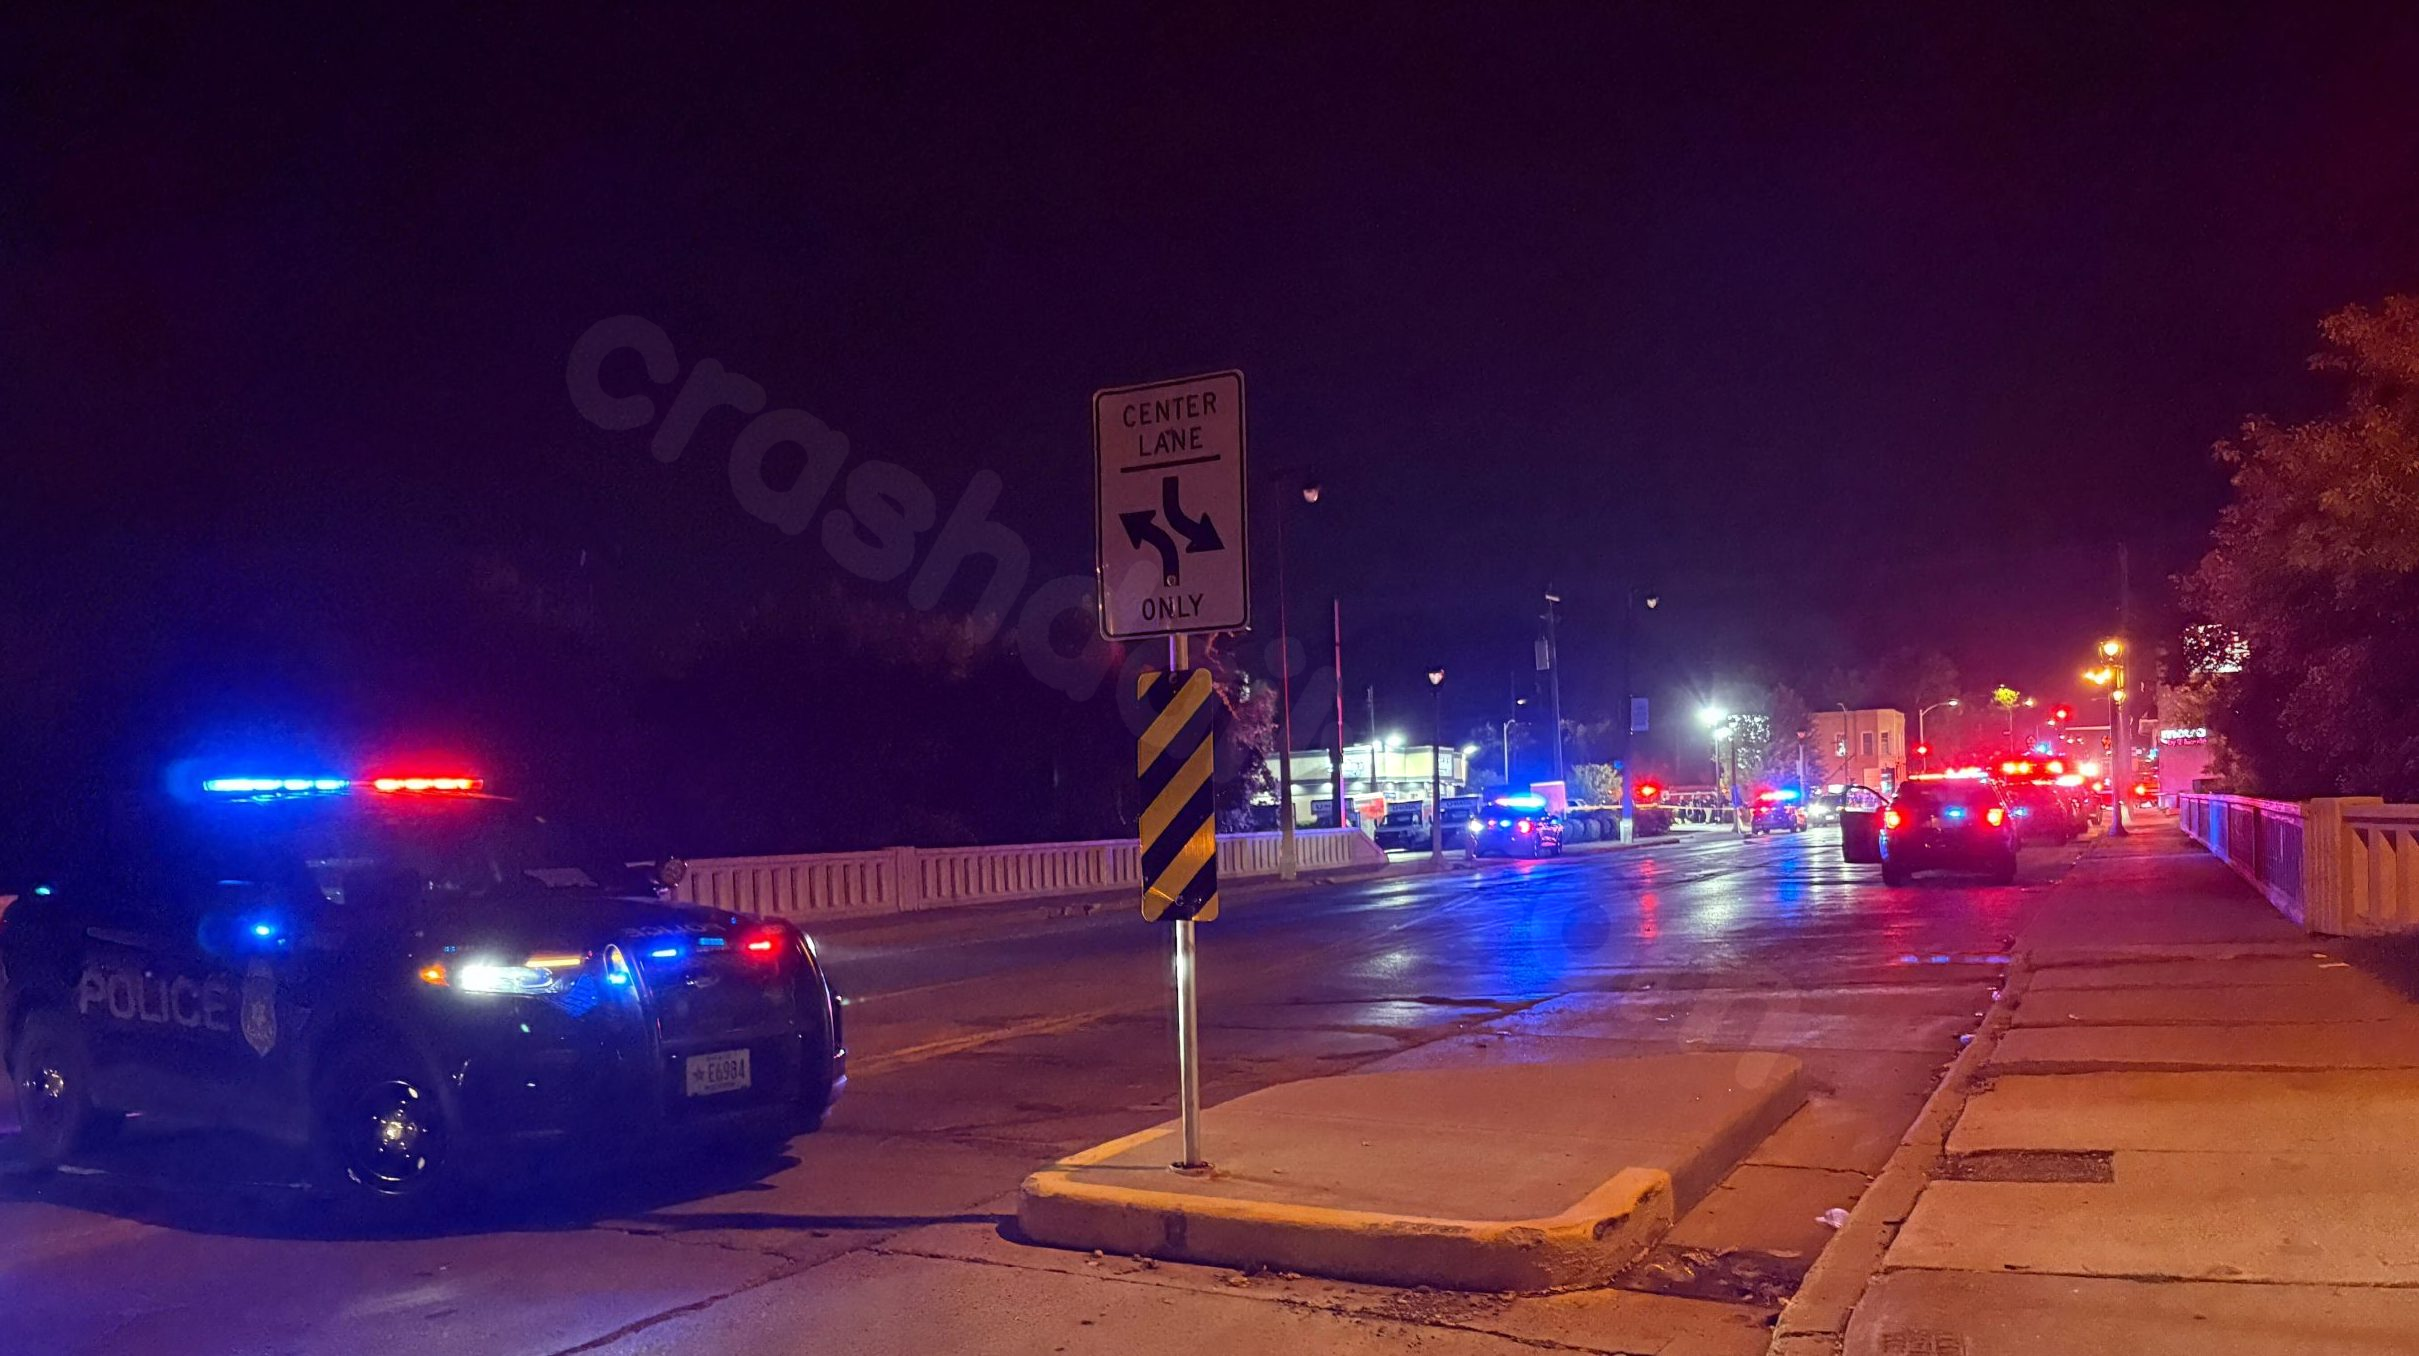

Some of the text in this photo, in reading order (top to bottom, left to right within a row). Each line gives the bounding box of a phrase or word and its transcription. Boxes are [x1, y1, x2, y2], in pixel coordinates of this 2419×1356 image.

[1122, 391, 1217, 428] CENTER
[1139, 427, 1203, 457] LANE
[1142, 593, 1203, 621] ONLY
[78, 967, 231, 1032] POLICE
